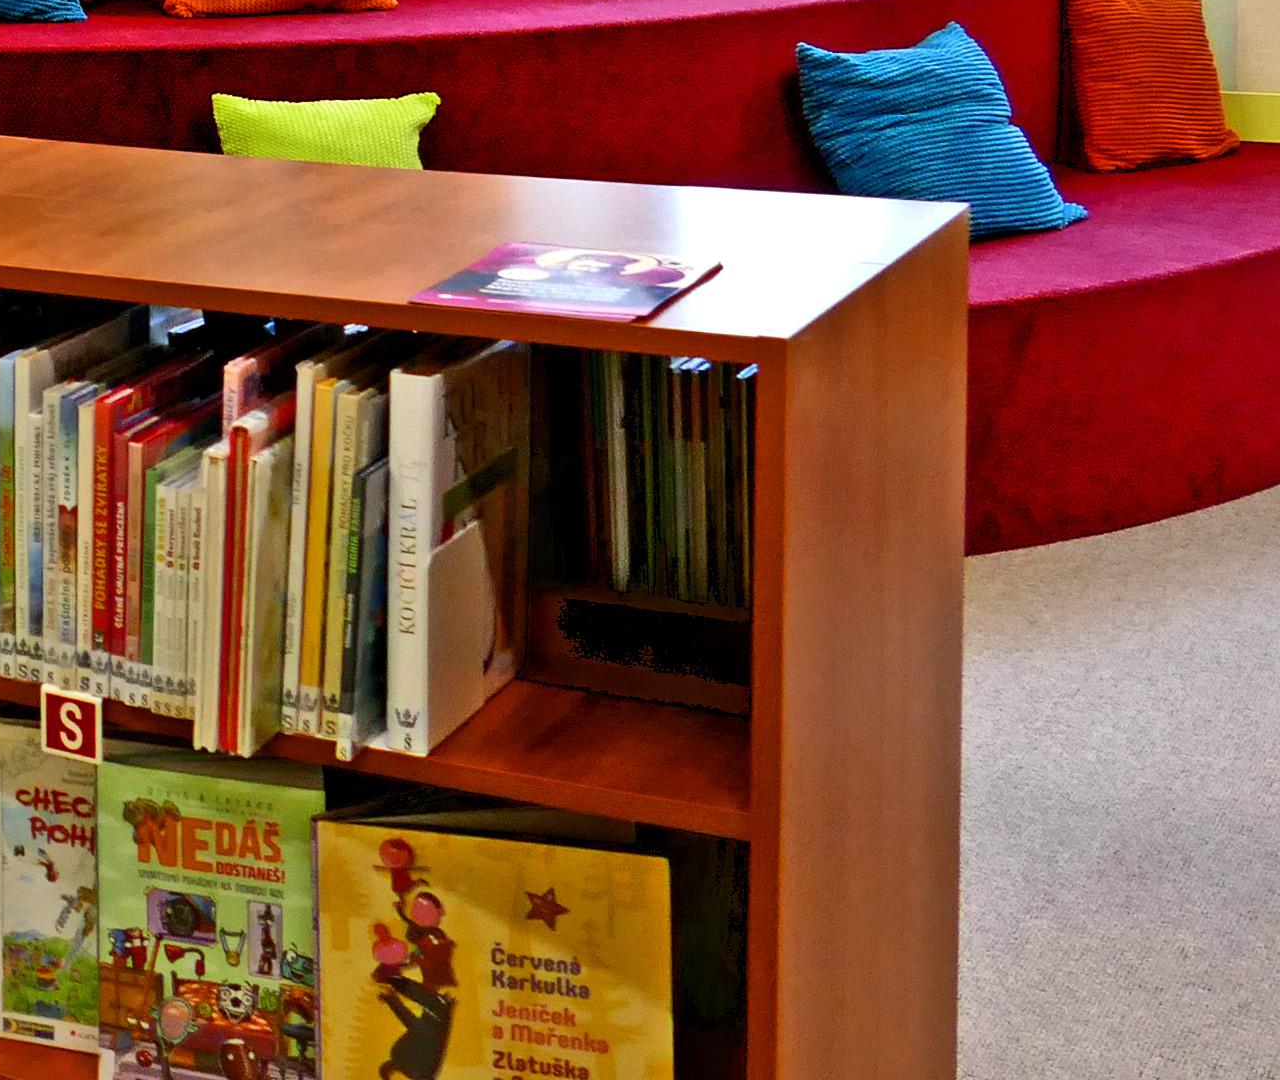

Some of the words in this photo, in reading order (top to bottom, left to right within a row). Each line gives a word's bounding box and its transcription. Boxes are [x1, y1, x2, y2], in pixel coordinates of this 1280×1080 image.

[339, 414, 355, 452] KOČKU
[95, 445, 106, 515] ZVÍŘÁTKY
[339, 455, 352, 476] PRO
[45, 495, 56, 519] hledá
[337, 479, 351, 530] POHÁDKY
[96, 519, 106, 536] SE
[95, 540, 106, 610] POHÁDKY
[59, 701, 83, 751] S
[215, 861, 286, 885] DOSTANEŠ!
[491, 942, 582, 975] Červená
[491, 969, 591, 999] Karkulka
[491, 999, 577, 1027] Jeníček
[492, 1025, 504, 1040] a
[511, 1023, 610, 1055] Mařenka
[492, 1050, 590, 1080] Zlatuška
